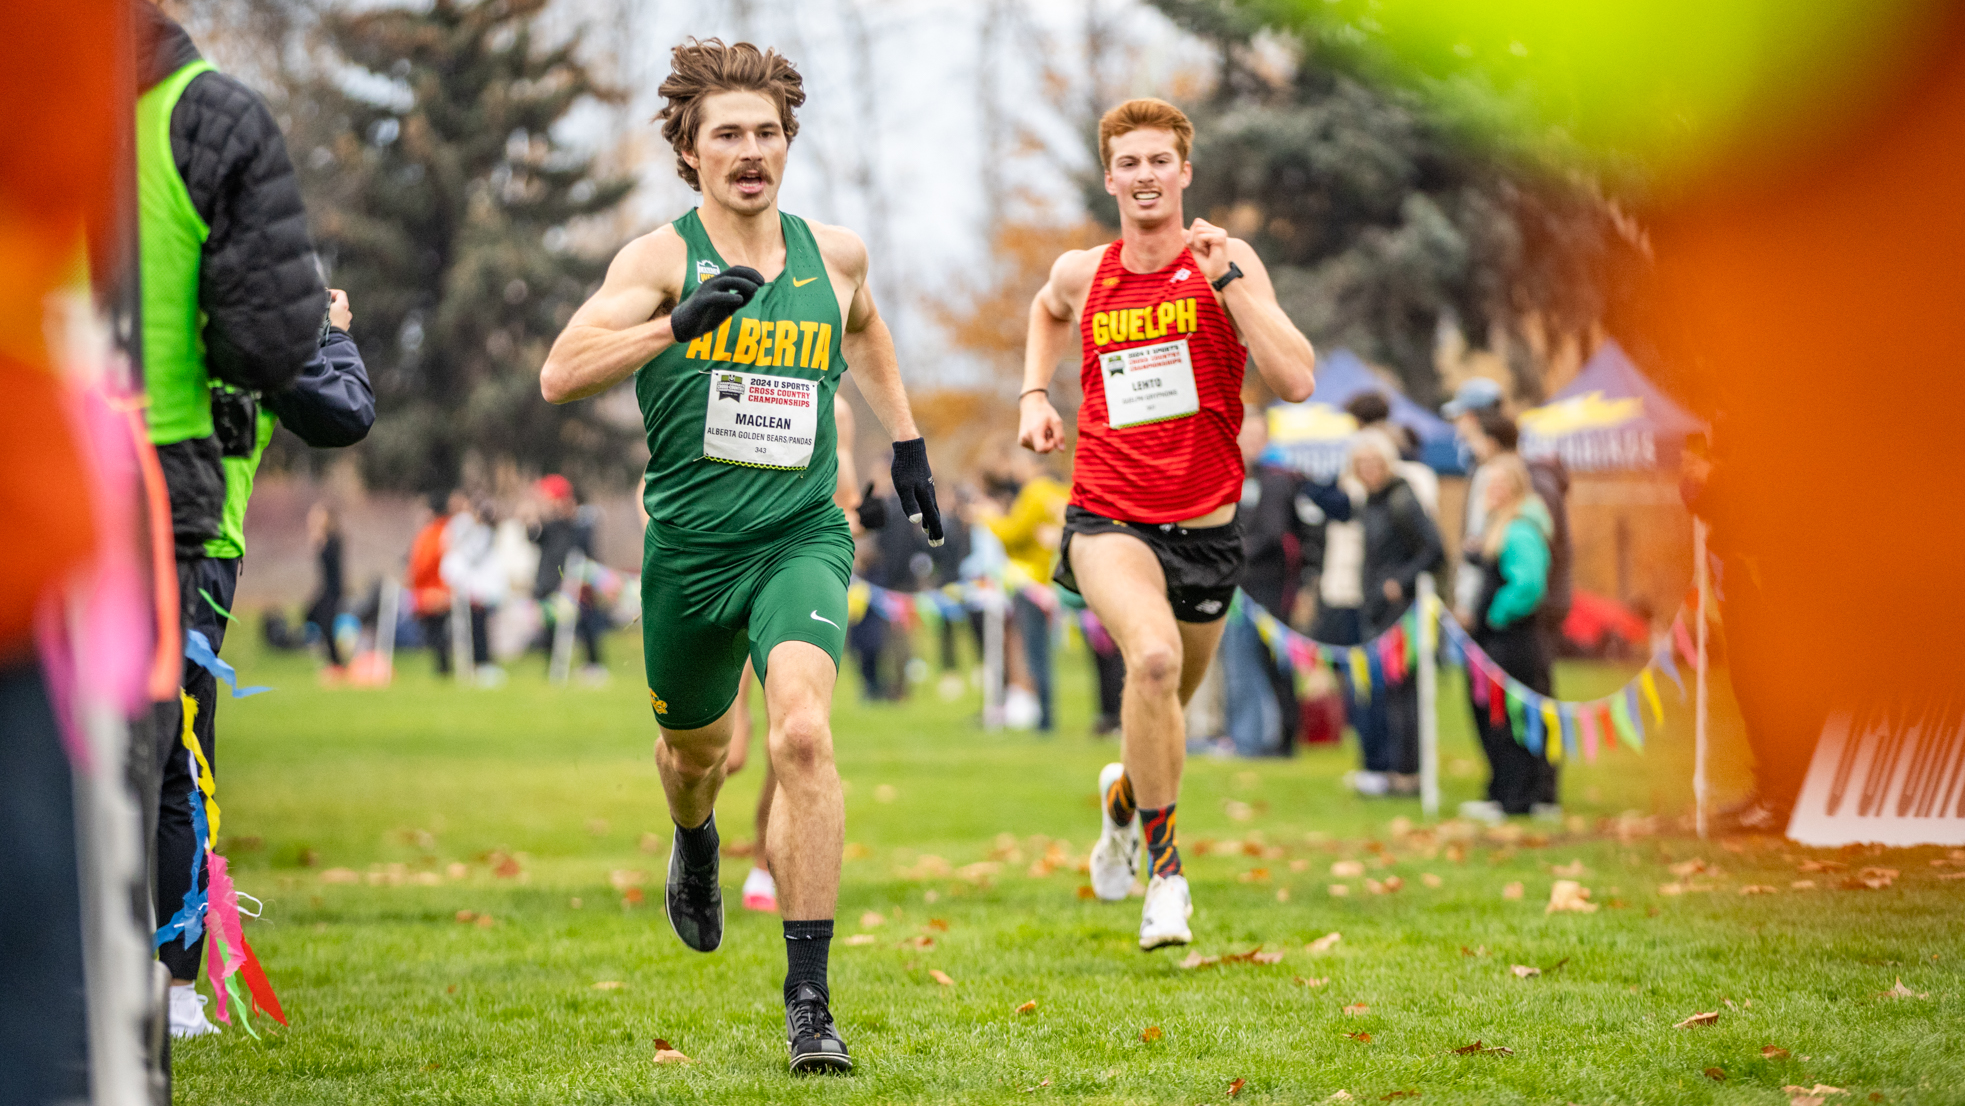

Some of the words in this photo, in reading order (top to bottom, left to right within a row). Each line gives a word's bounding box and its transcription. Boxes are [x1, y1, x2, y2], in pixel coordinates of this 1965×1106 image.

[1092, 297, 1198, 347] GUELPH
[685, 316, 832, 371] ALBERTA
[750, 378, 771, 388] 2024
[774, 380, 780, 388] U
[781, 381, 810, 391] SPORTS
[748, 394, 810, 408] CHAMPIONSHIPS
[749, 386, 775, 396] CROSS
[776, 389, 811, 400] COUNTRY
[735, 412, 792, 430] MACLEAN
[707, 427, 737, 438] ALBERTA
[738, 430, 765, 441] GOLDEN
[766, 434, 812, 446] BEARS/PANDAS
[754, 446, 767, 454] 343
